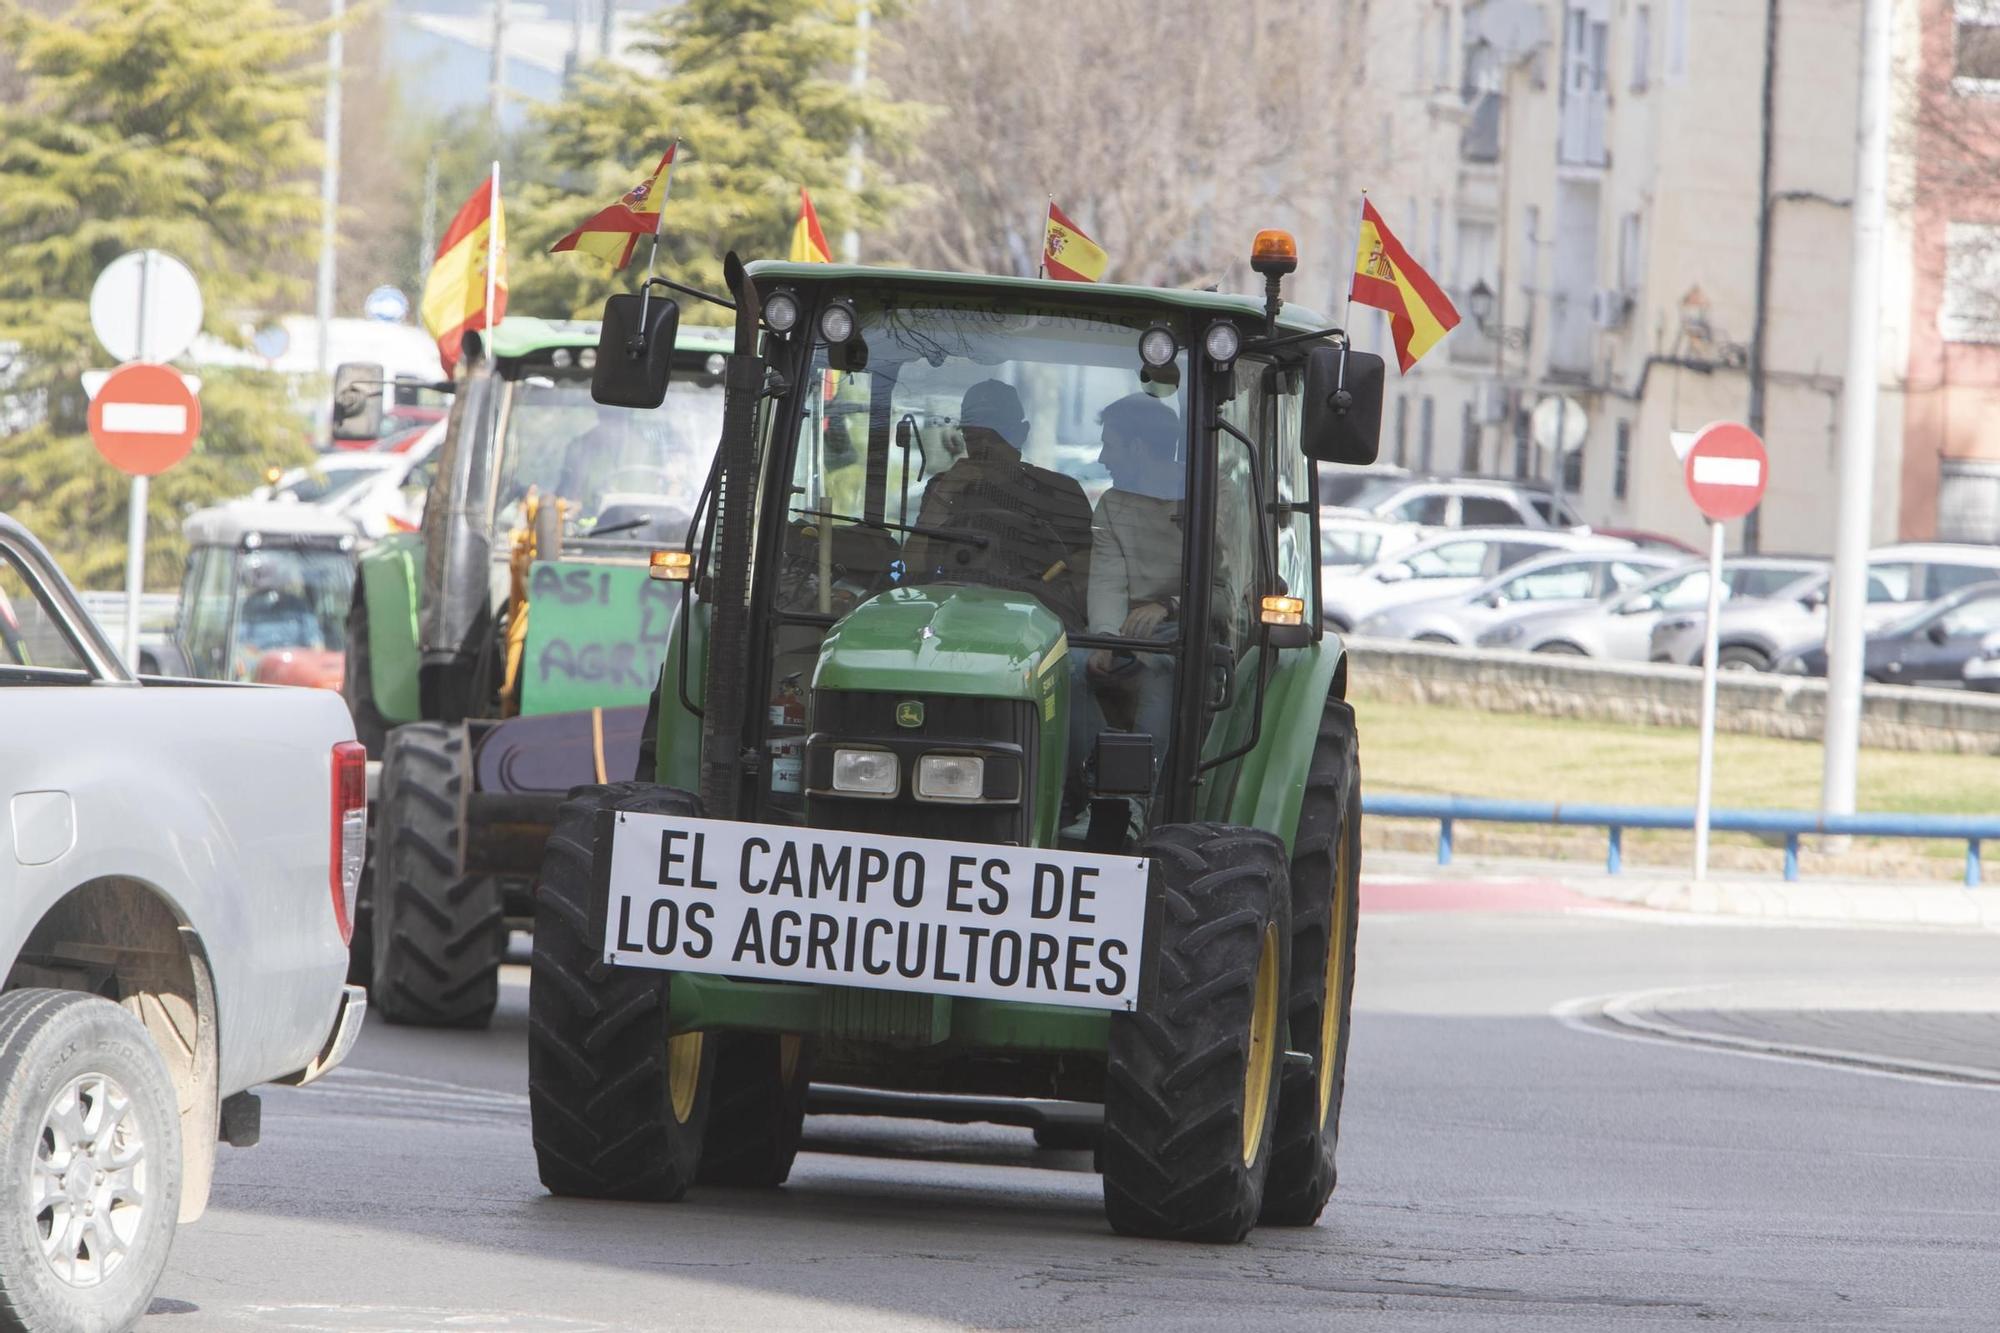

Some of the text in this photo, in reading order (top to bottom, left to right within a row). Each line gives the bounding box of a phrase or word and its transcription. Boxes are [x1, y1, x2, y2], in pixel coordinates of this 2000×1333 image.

[533, 565, 610, 605] ASI
[658, 829, 1100, 923] EL CAMPO ES DE
[617, 895, 1128, 996] LOS AGRICULTORES
